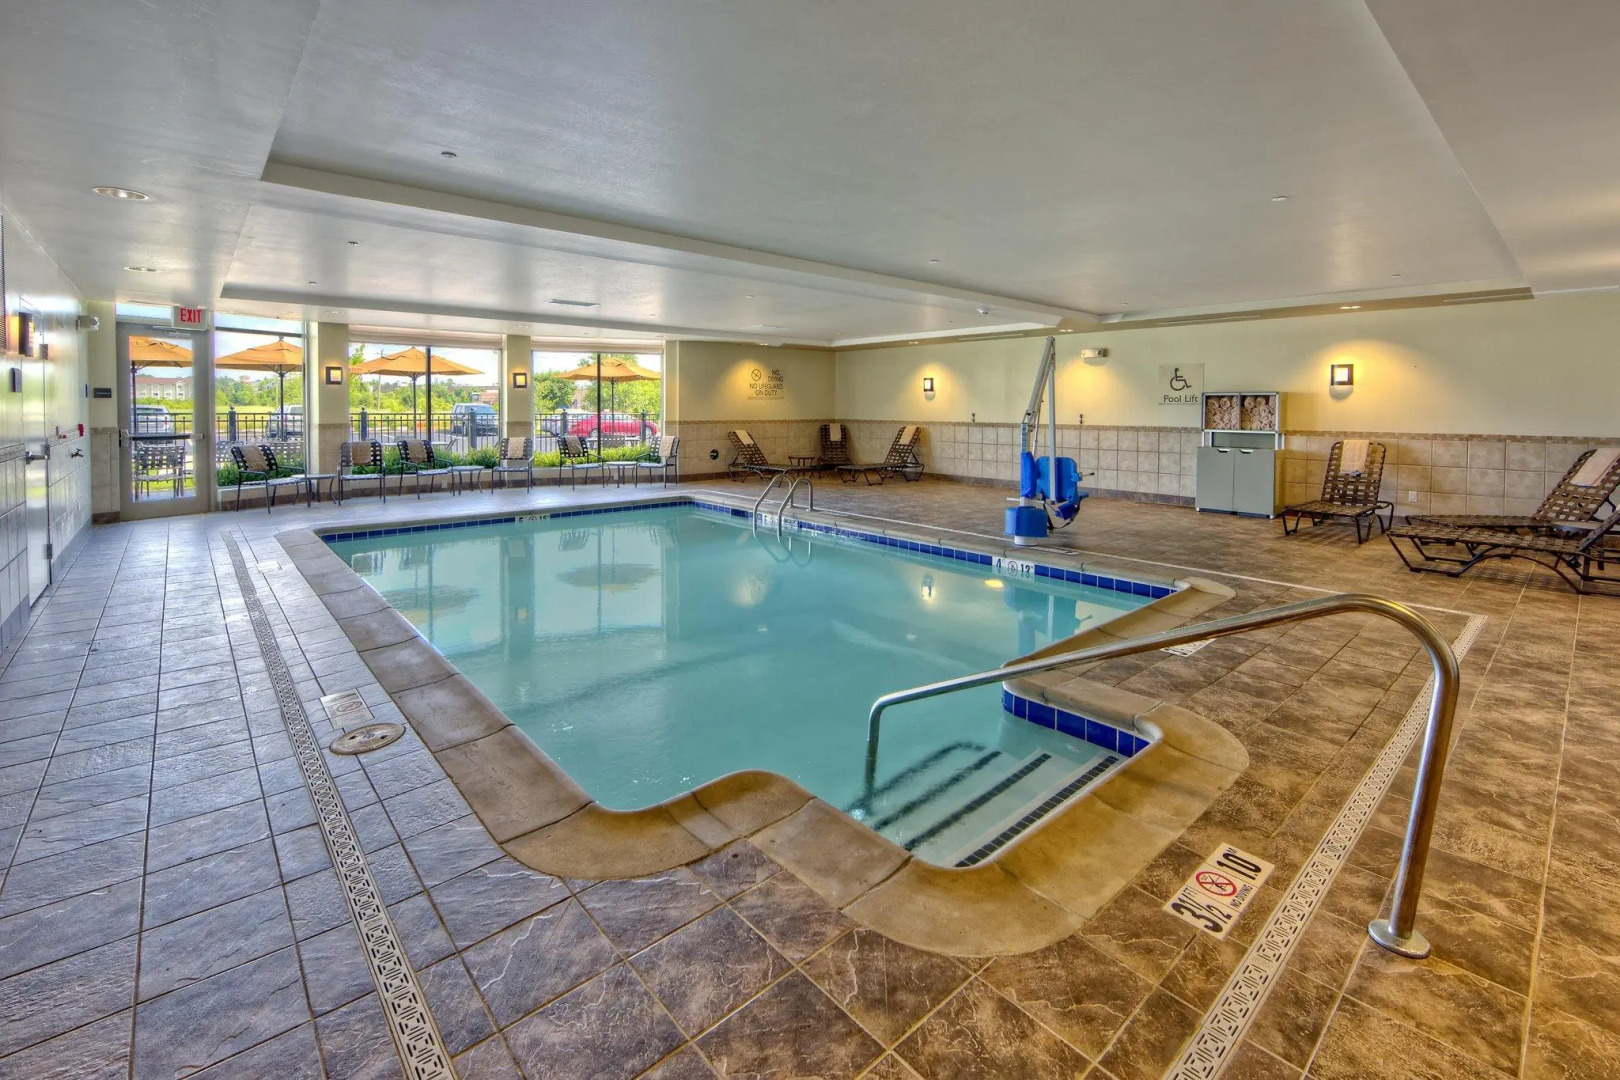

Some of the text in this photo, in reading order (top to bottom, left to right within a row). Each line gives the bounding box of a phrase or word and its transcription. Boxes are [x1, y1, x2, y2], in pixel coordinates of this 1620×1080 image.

[180, 308, 202, 323] EXIT
[1164, 395, 1198, 403] Pool Lift
[1235, 884, 1253, 902] DIVING
